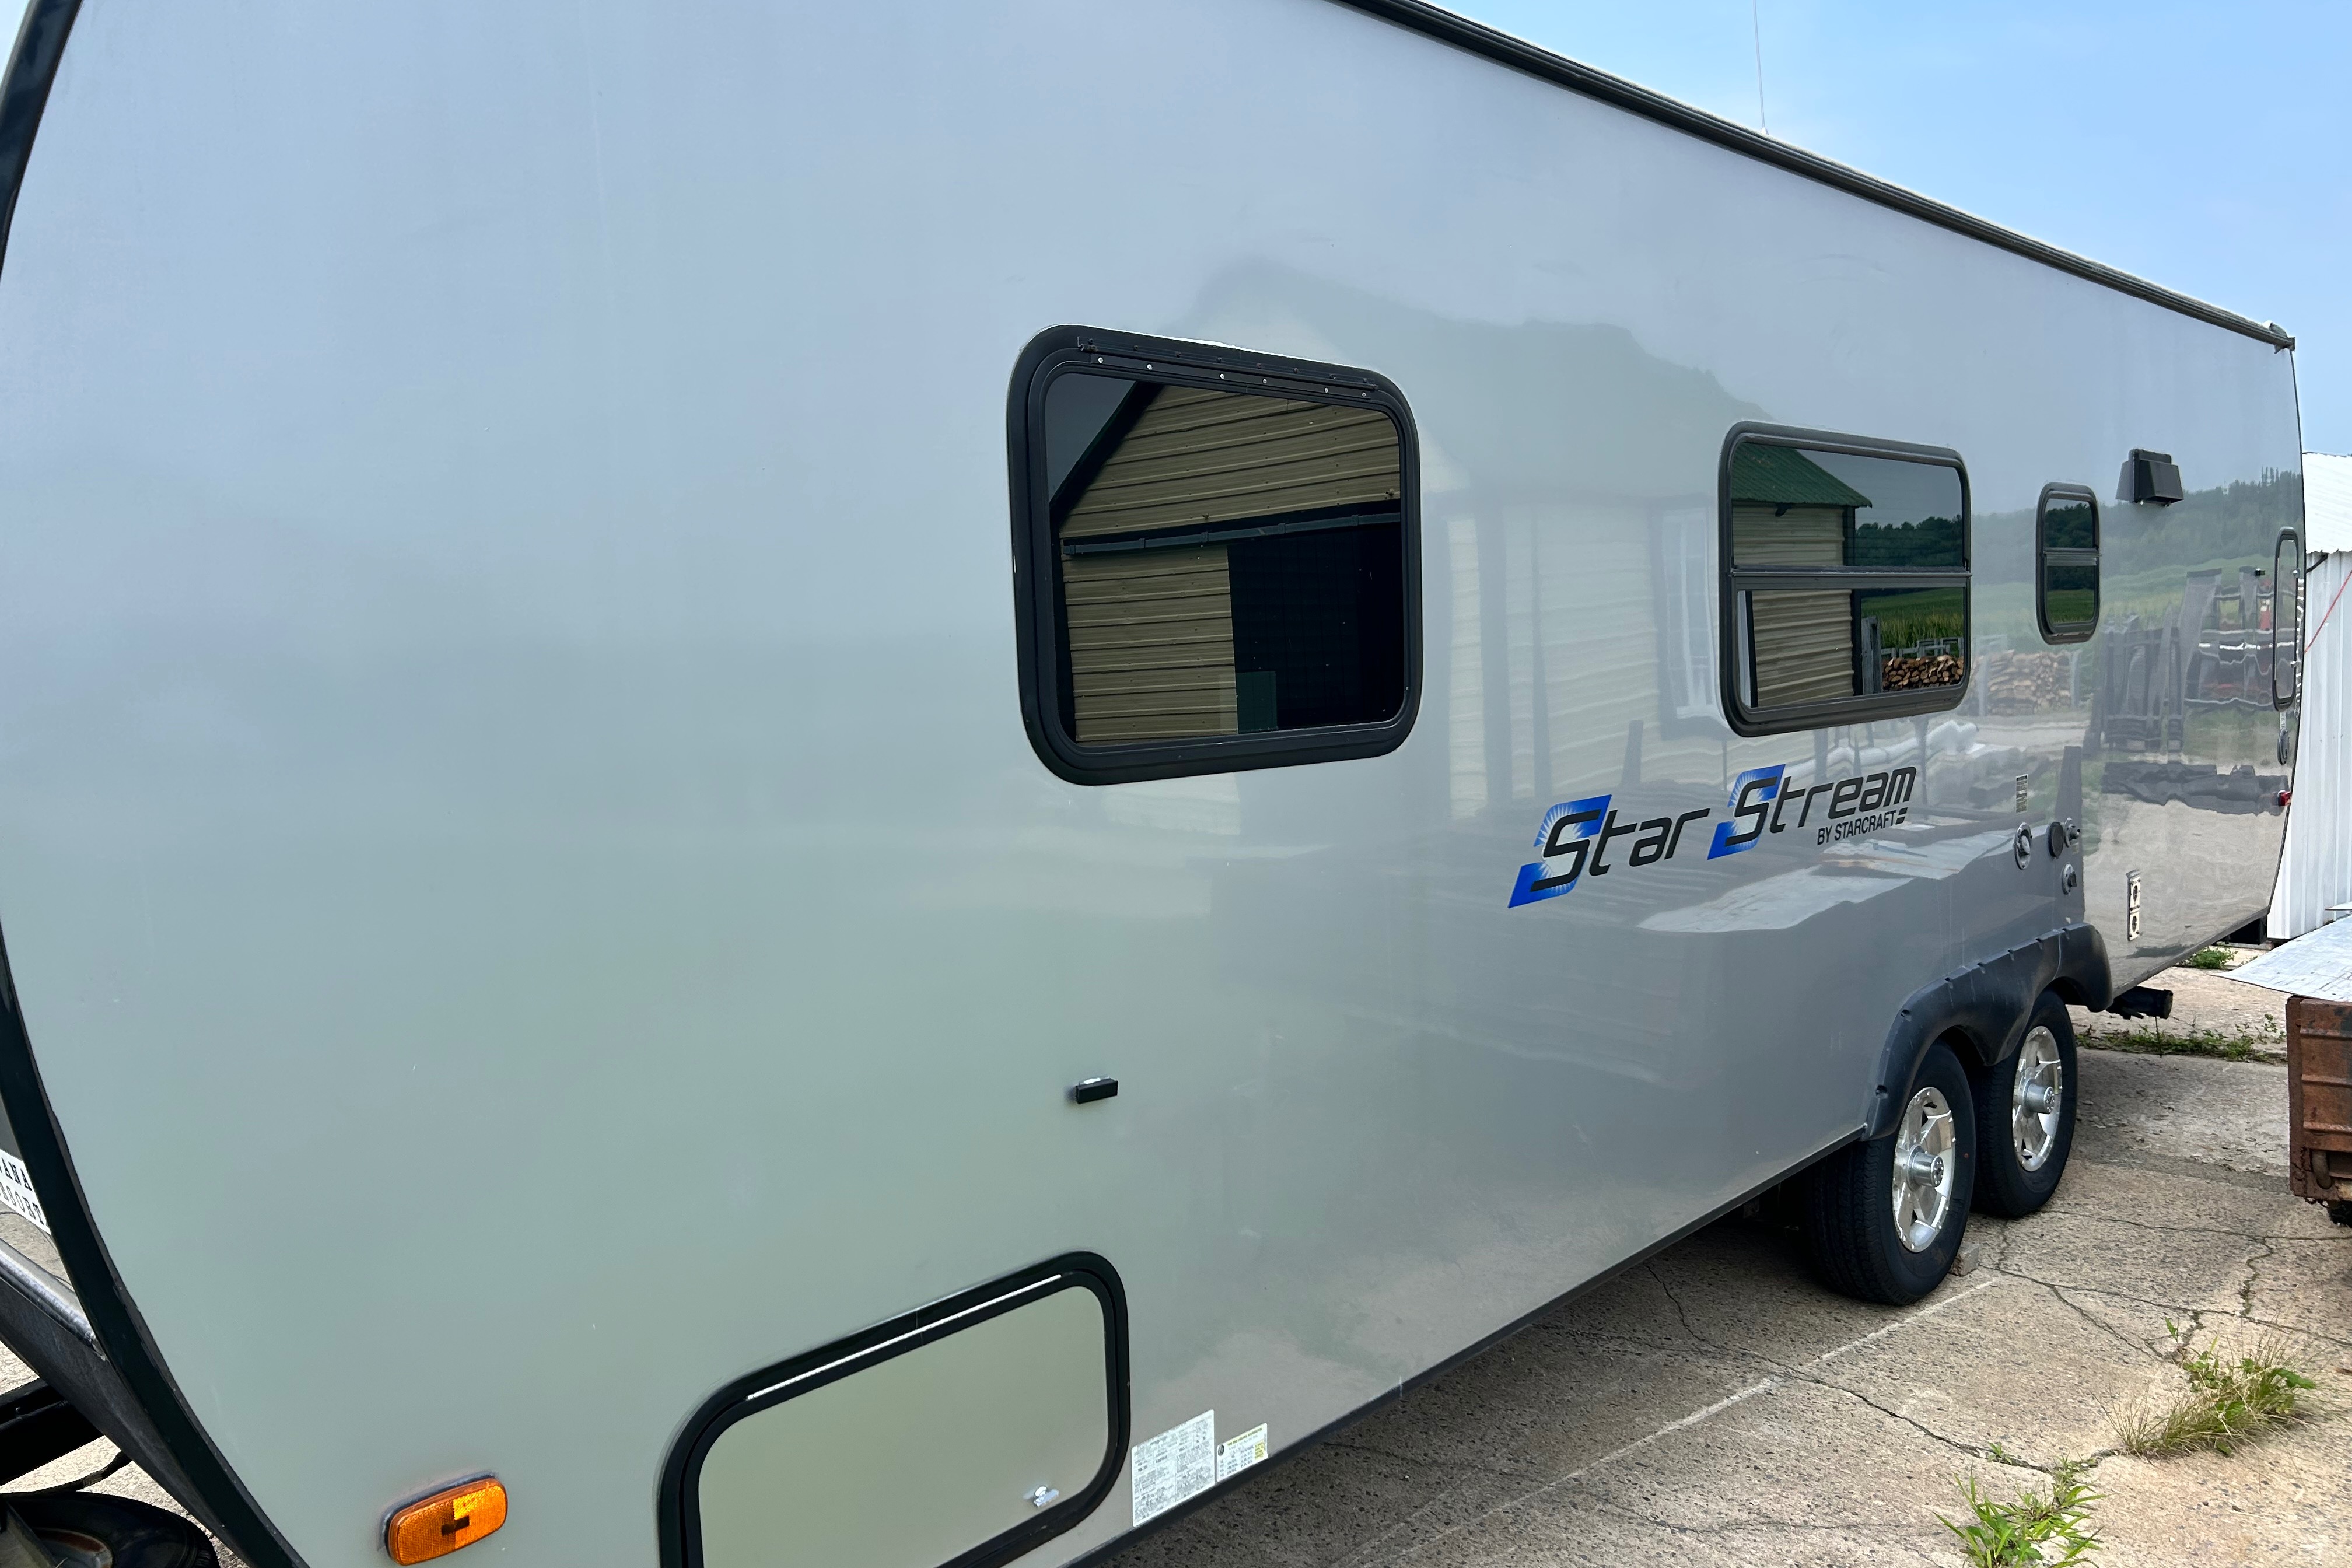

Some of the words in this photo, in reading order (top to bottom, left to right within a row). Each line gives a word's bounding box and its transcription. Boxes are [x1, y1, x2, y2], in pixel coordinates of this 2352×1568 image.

[1530, 807, 1711, 892] Star
[1725, 766, 1917, 846] Stream
[1817, 825, 1833, 846] BY
[1834, 810, 1897, 841] STARCRAFT
